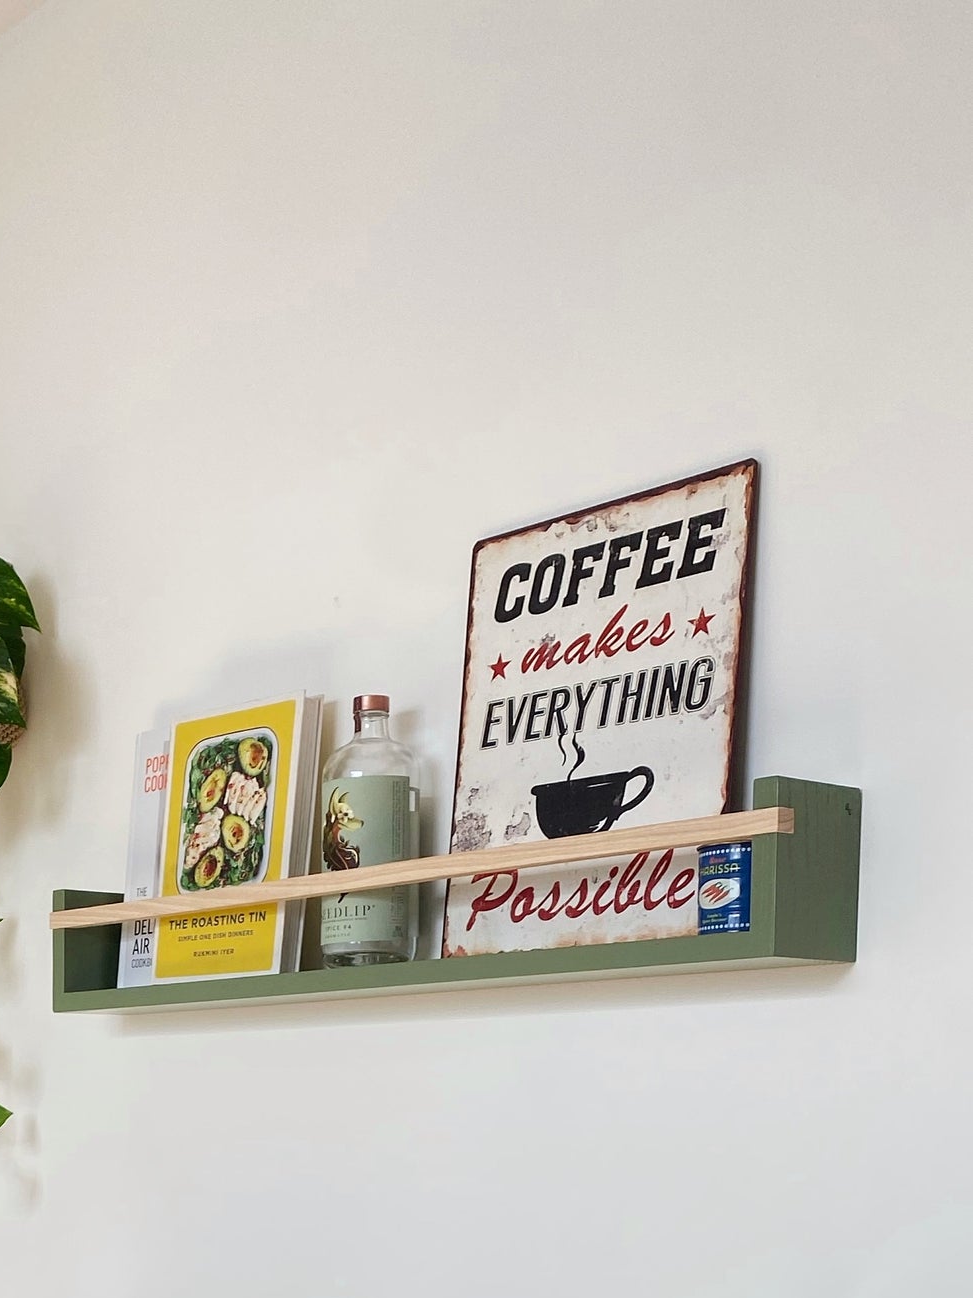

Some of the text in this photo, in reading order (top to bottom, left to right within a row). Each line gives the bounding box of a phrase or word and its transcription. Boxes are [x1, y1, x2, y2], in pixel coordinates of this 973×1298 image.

[494, 508, 727, 623] COFFEE
[521, 604, 675, 673] makes
[480, 655, 716, 750] EVERYTHING
[136, 886, 148, 897] THE
[466, 849, 695, 931] Possible
[134, 918, 156, 936] DEL
[169, 911, 267, 931] THE ROASTING TIN
[132, 938, 150, 955] AIR
